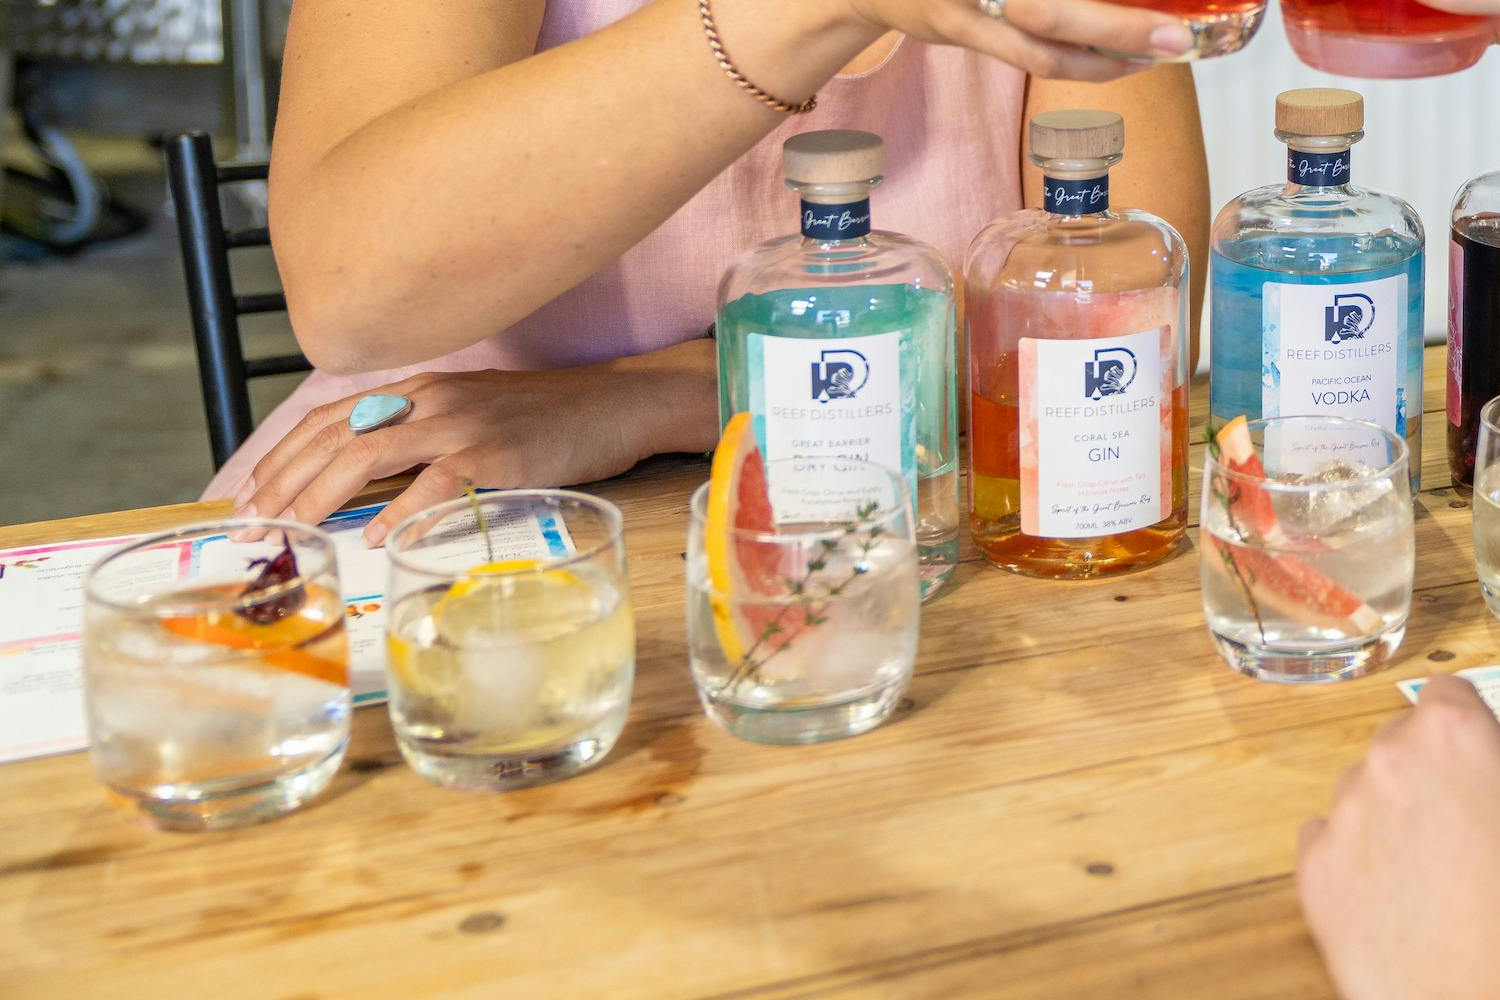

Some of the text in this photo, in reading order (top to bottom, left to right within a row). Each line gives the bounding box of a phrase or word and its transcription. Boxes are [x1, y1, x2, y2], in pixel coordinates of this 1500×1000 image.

[1299, 159, 1333, 177] Great
[1055, 187, 1091, 206] Great
[804, 210, 839, 230] Great
[1287, 342, 1392, 361] REEF DISTILLERS
[1311, 374, 1372, 385] PACIFIC OCEAN
[1311, 388, 1371, 406] VODKA
[773, 403, 893, 421] REEF DISTILLERS
[1046, 396, 1156, 418] REEF DISTILLERS
[792, 437, 870, 449] GREAT BARRIER
[1074, 430, 1130, 442] CORAL SEA
[1088, 446, 1120, 462] GIN
